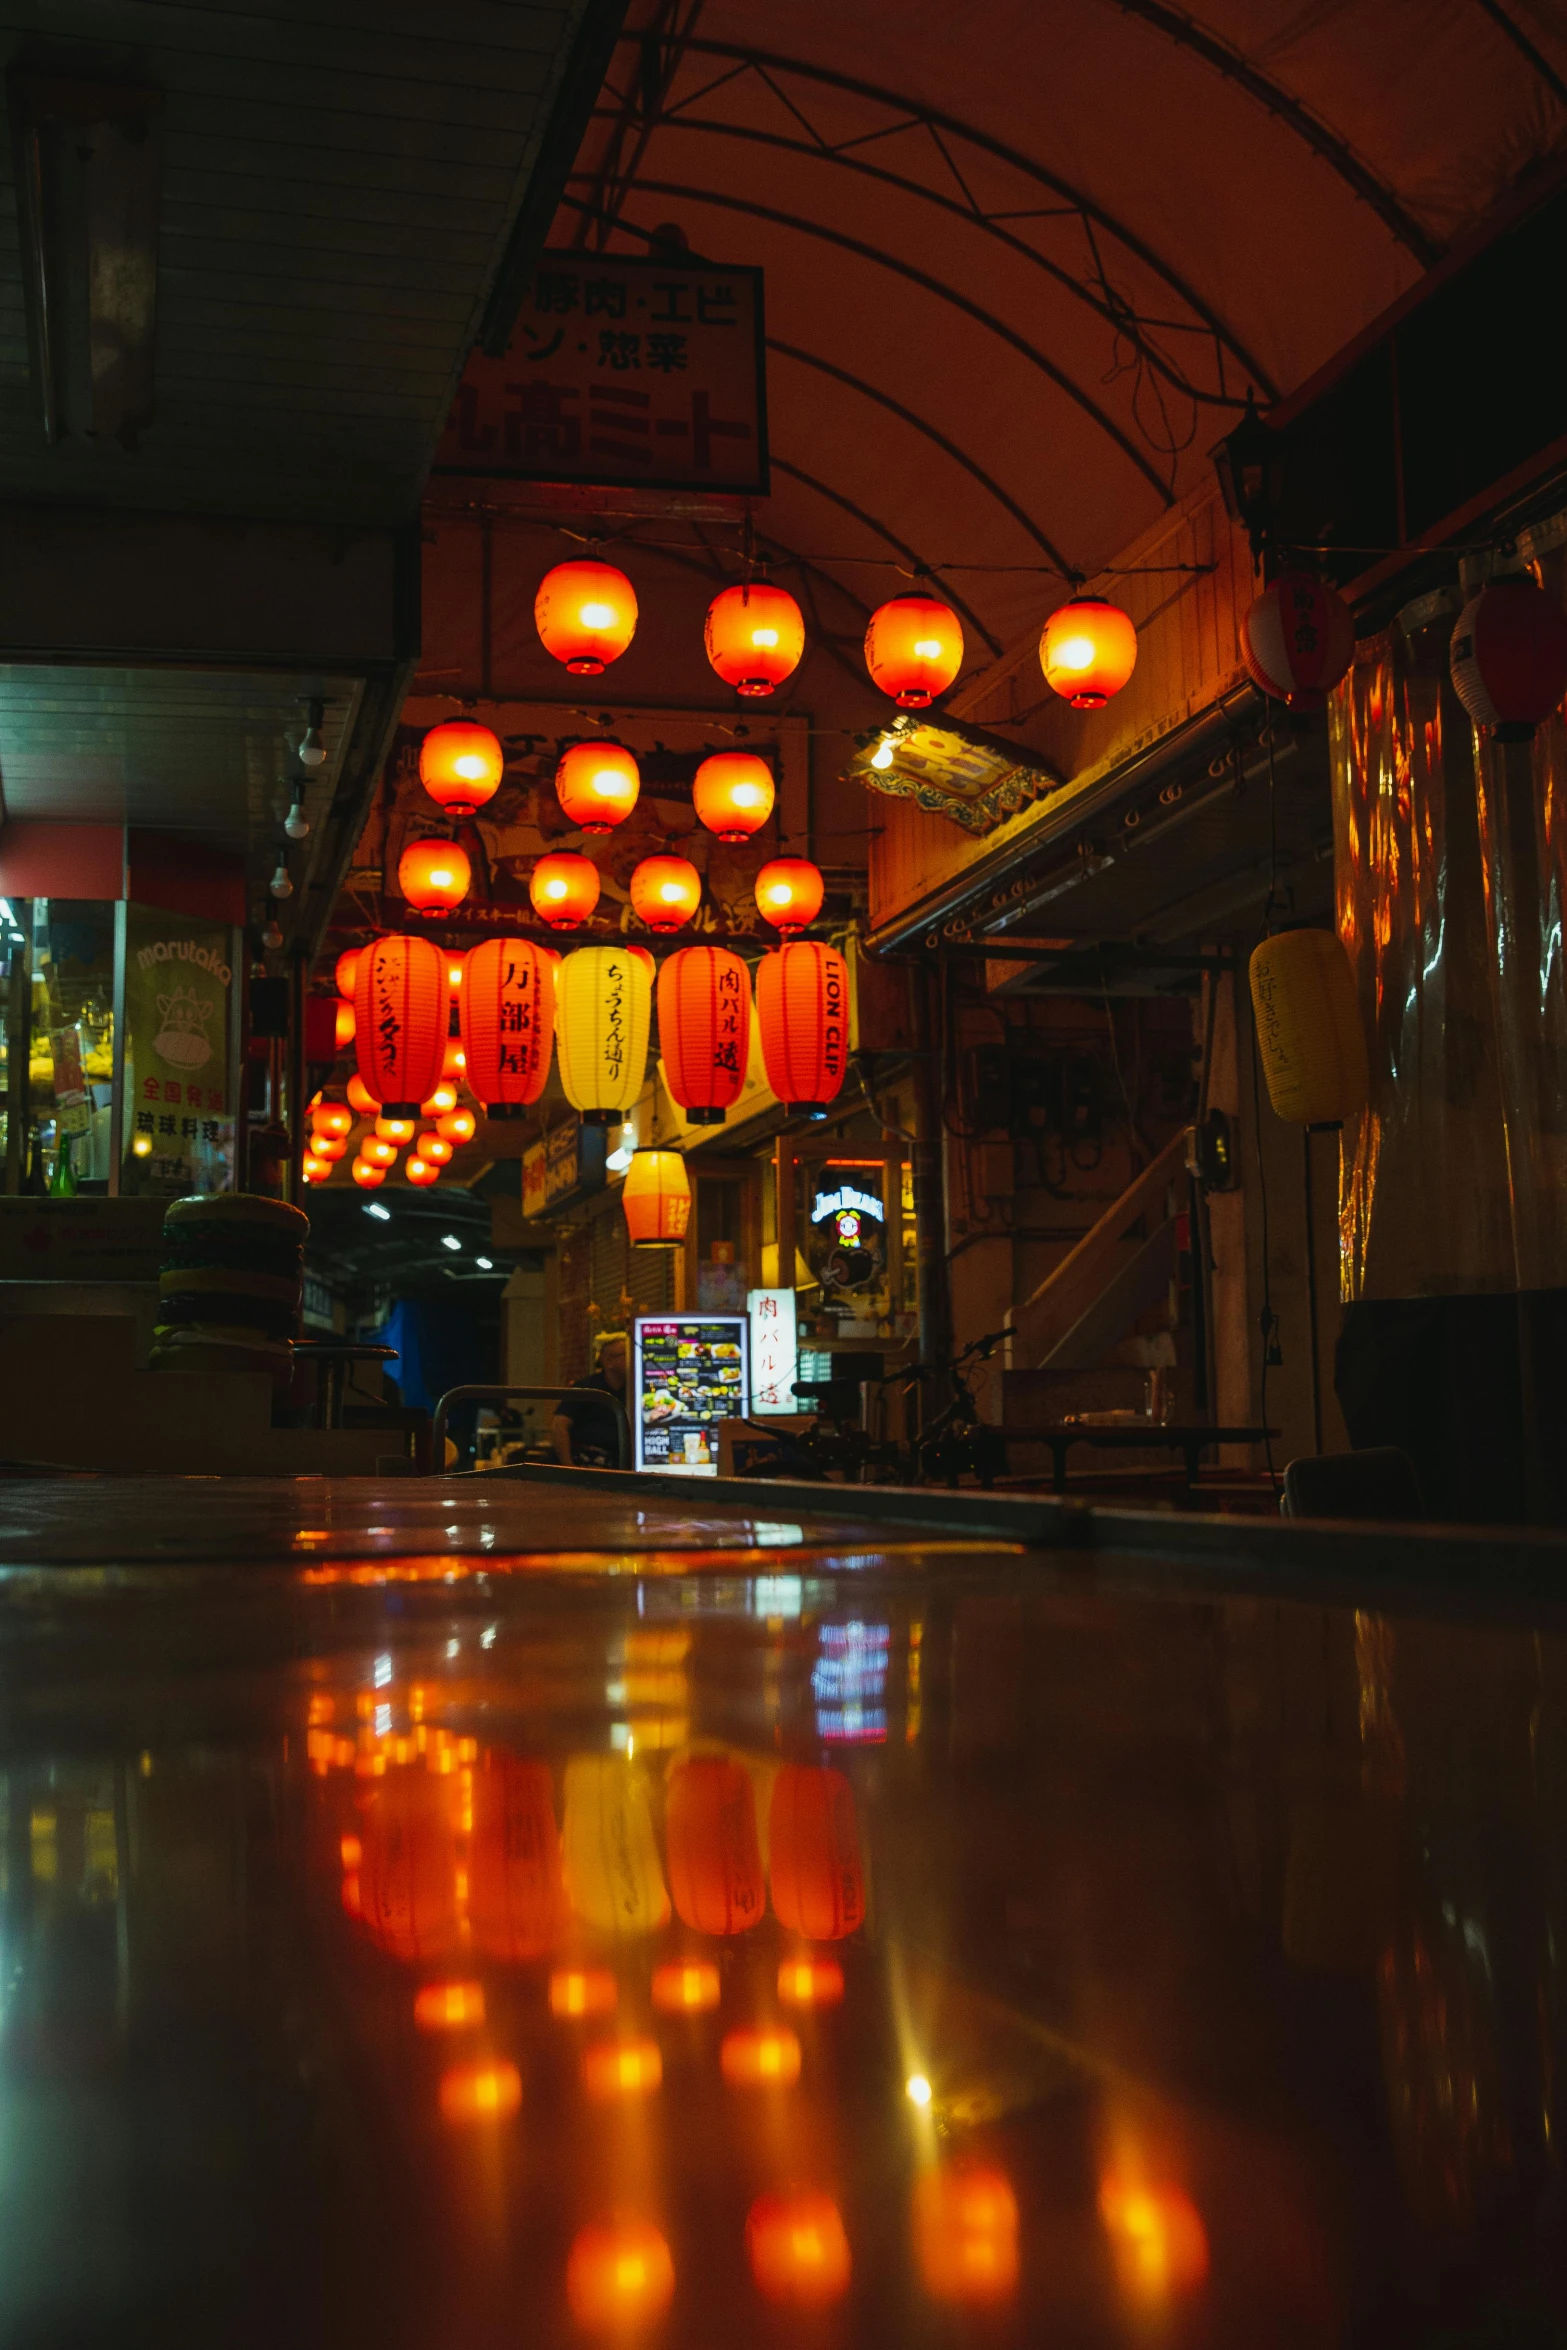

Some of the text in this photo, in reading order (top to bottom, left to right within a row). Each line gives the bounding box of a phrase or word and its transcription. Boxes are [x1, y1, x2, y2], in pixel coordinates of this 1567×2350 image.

[604, 963, 625, 1082] ちょうちん通り
[825, 960, 840, 1076] LION CLIP
[136, 1110, 220, 1143] 琉球料理
